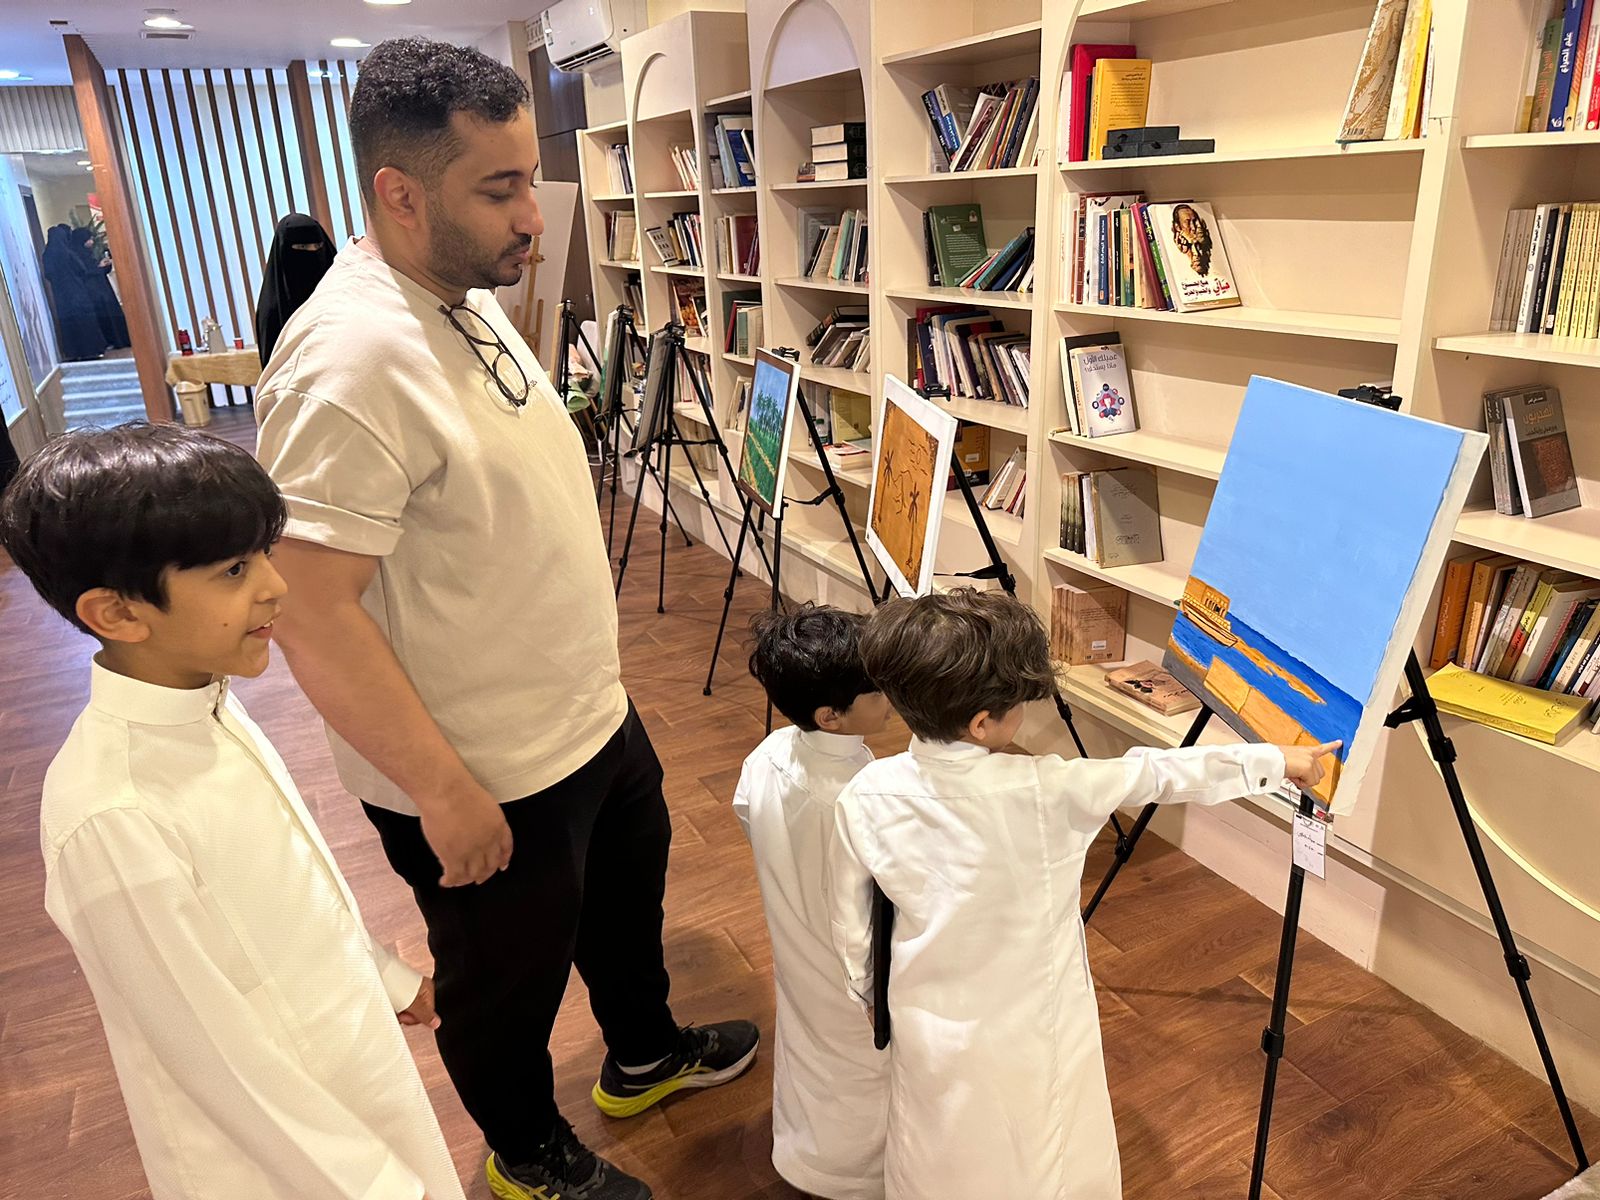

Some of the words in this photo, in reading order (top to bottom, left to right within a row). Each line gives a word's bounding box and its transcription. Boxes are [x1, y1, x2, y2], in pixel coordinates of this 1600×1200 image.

[1563, 32, 1574, 47] علم
[1560, 48, 1570, 74] الصراع
[1099, 354, 1117, 363] عميلك
